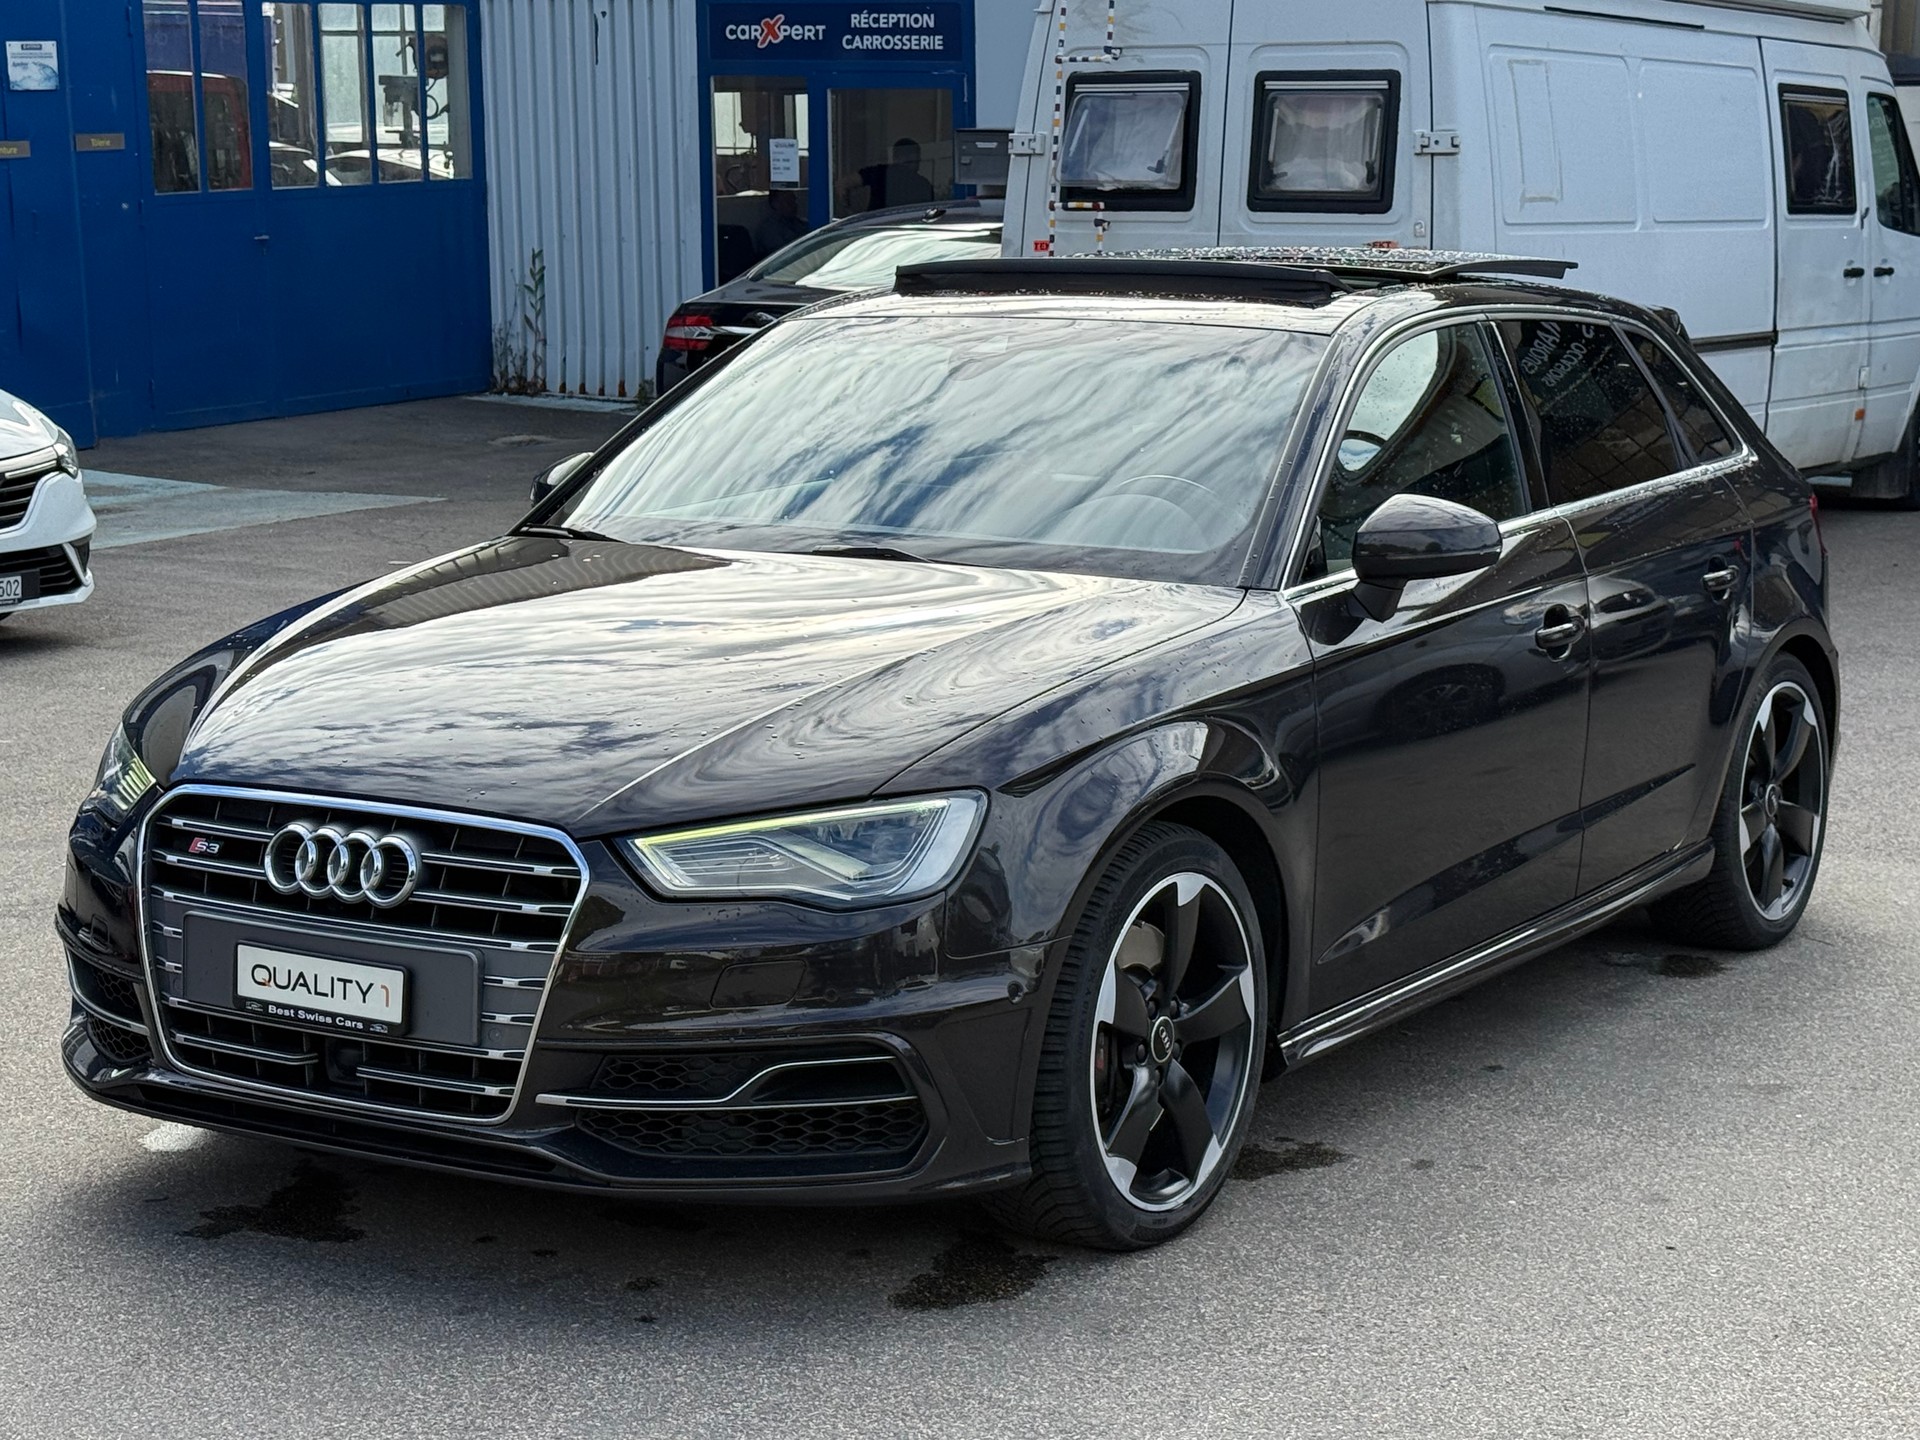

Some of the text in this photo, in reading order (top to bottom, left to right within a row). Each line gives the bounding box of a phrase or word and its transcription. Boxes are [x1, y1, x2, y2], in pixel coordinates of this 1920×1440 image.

[850, 10, 935, 29] RÉCEPTION
[842, 35, 944, 50] CARROSSERIE
[193, 840, 220, 854] S3
[251, 963, 390, 1008] QUALITY 1
[268, 1004, 295, 1018] Best
[297, 1010, 333, 1024] Swiss
[335, 1016, 364, 1030] Cars
